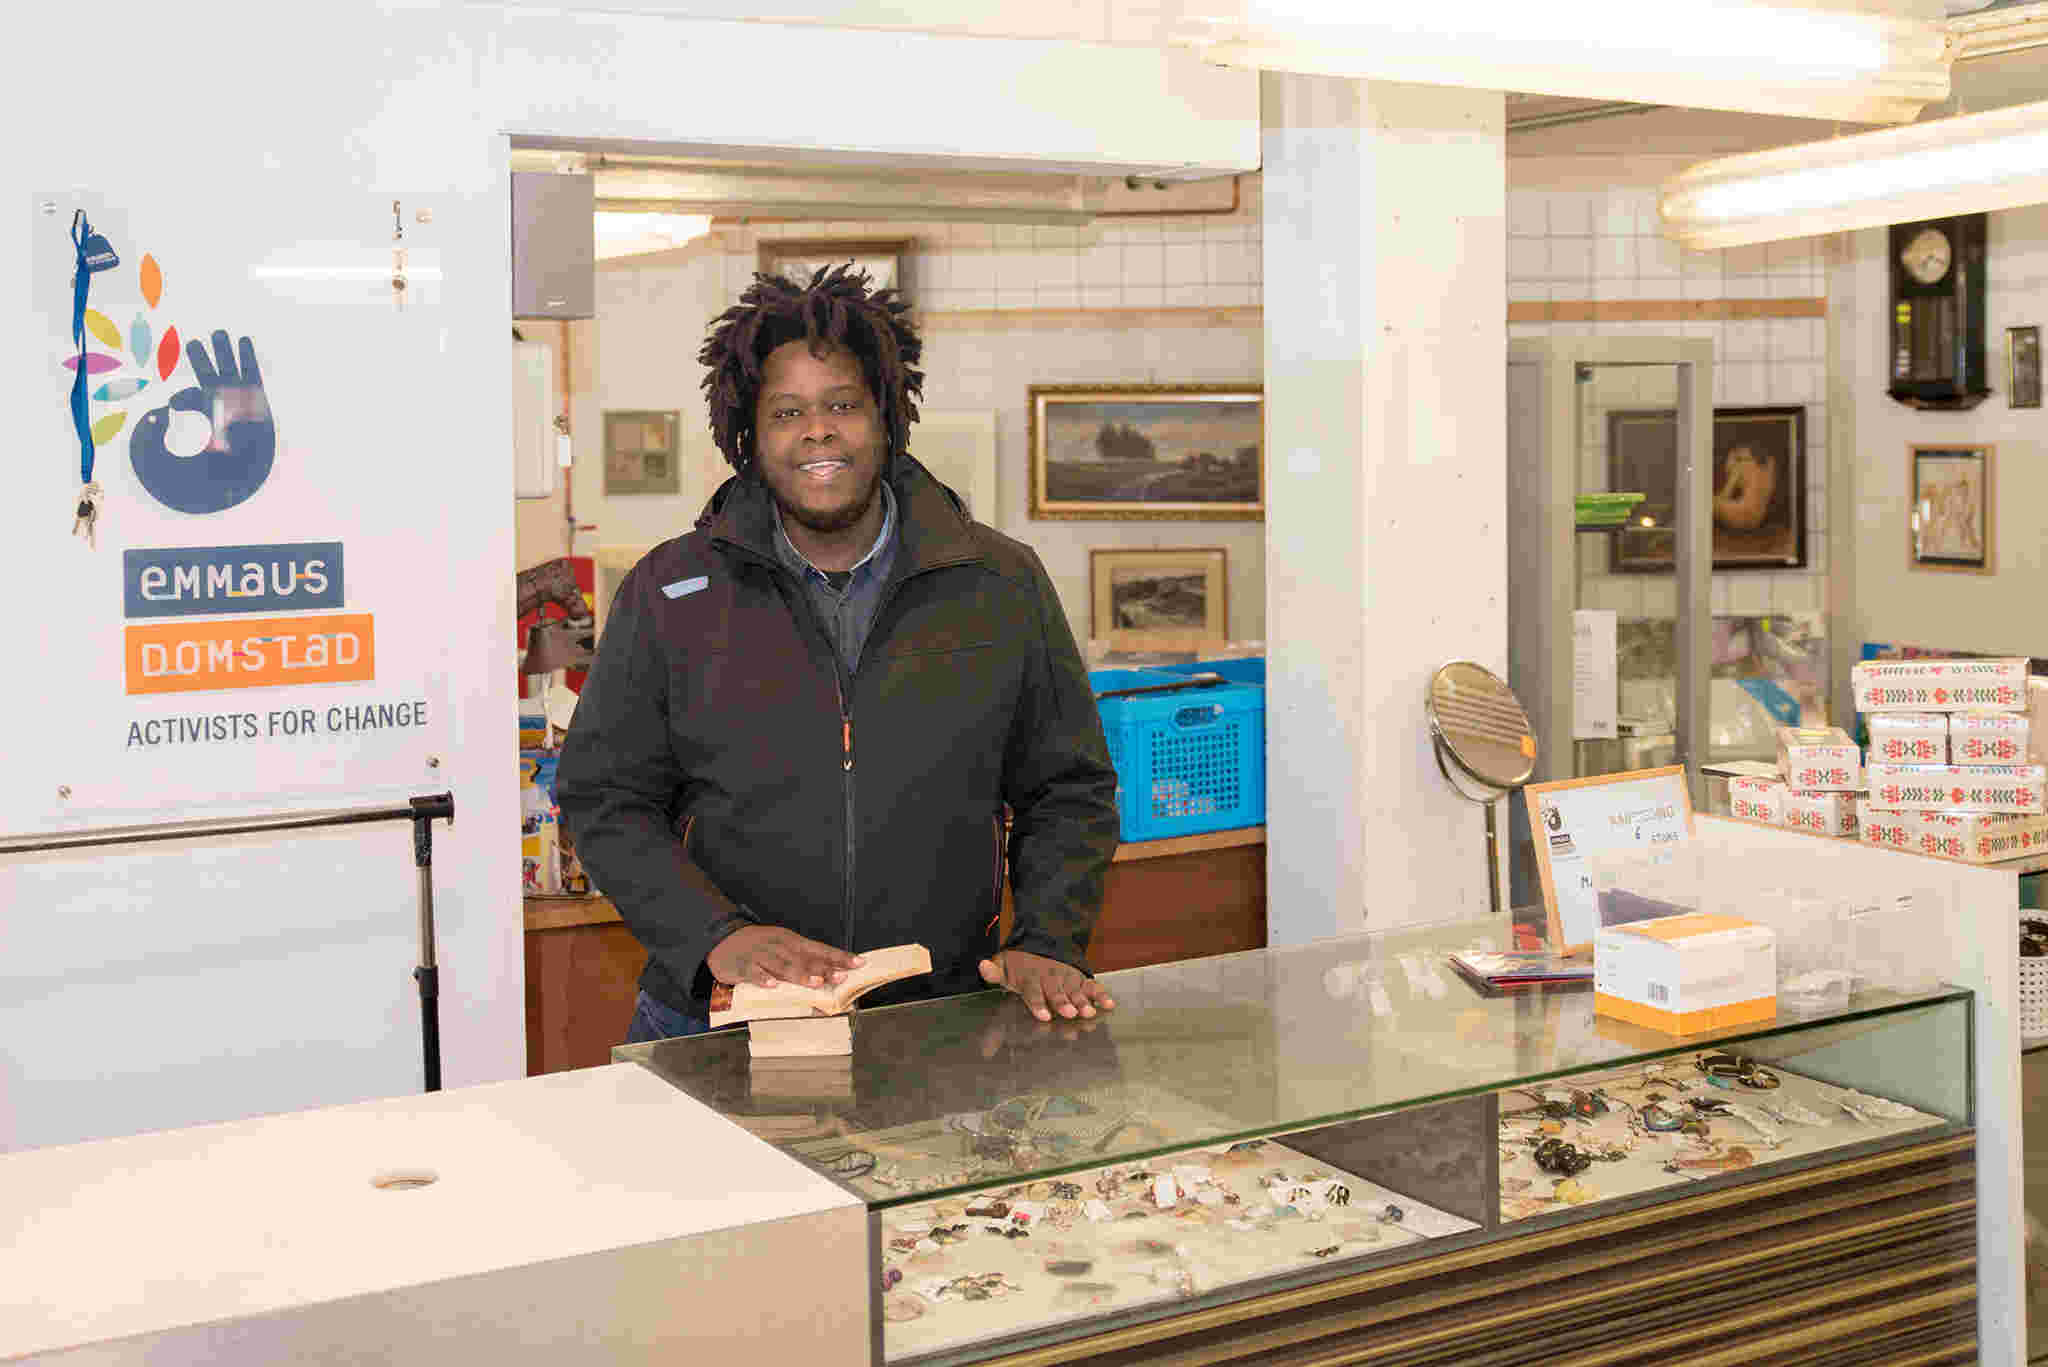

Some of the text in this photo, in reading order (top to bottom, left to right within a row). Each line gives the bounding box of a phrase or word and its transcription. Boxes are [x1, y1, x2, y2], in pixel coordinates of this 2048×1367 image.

[127, 701, 428, 746] ACTIVISTS FOR CHANGE
